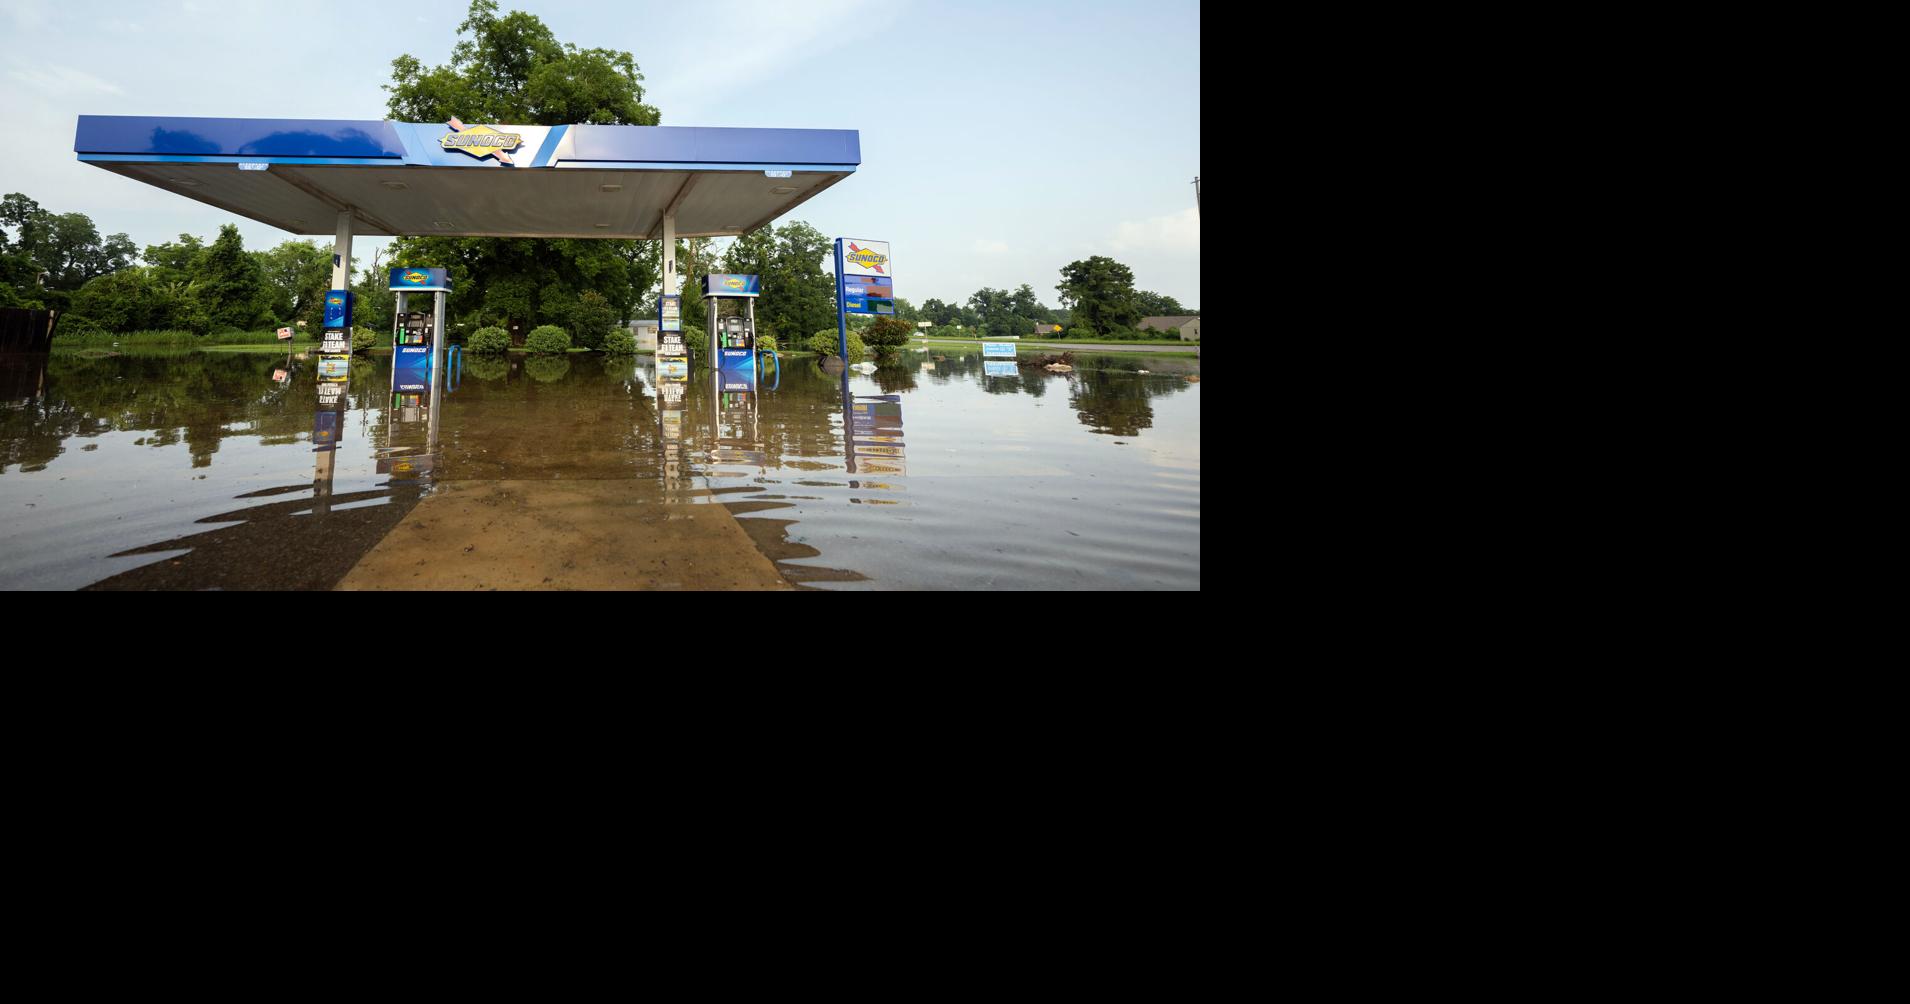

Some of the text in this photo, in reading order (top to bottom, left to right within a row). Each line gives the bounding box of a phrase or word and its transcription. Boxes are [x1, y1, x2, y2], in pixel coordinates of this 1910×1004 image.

[444, 134, 517, 147] SUNOCO
[849, 253, 885, 263] SUNOCO
[324, 332, 344, 341] STAKE
[663, 336, 682, 344] STAKE
